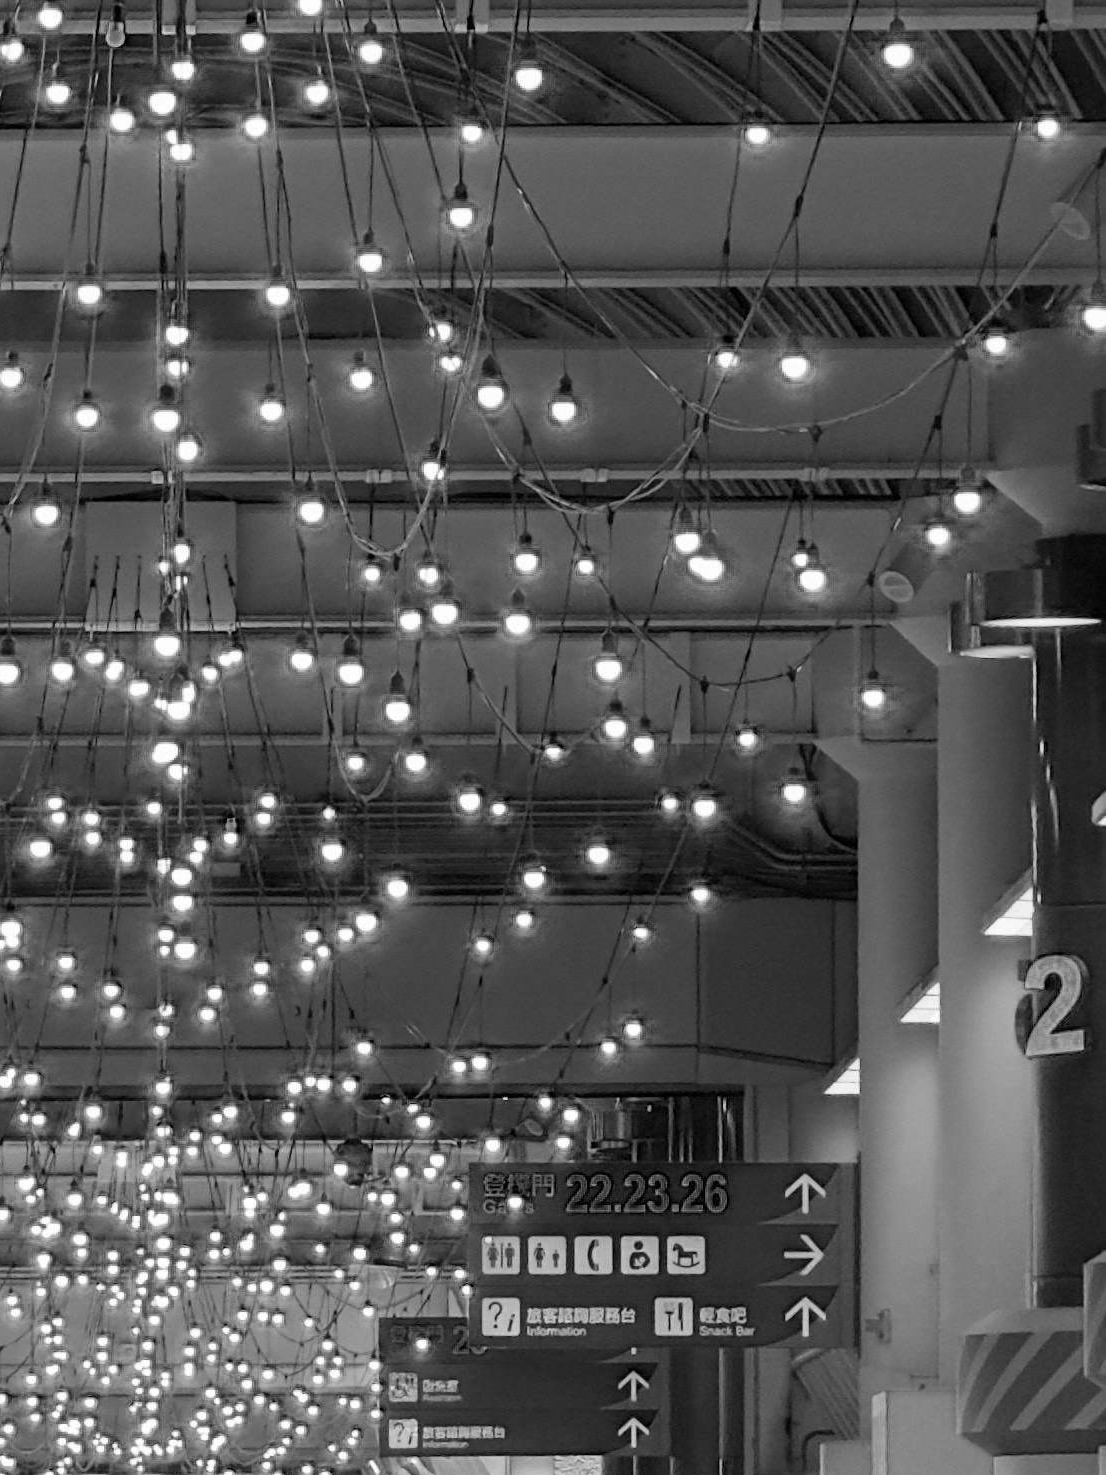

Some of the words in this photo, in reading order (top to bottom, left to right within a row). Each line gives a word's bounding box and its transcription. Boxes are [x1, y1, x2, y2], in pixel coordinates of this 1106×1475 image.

[1025, 954, 1086, 1057] 2
[565, 1173, 729, 1214] 22.23.26
[483, 1199, 534, 1215] Gas
[526, 1326, 587, 1337] Information
[699, 1326, 734, 1336] Snack
[736, 1326, 756, 1336] Bar
